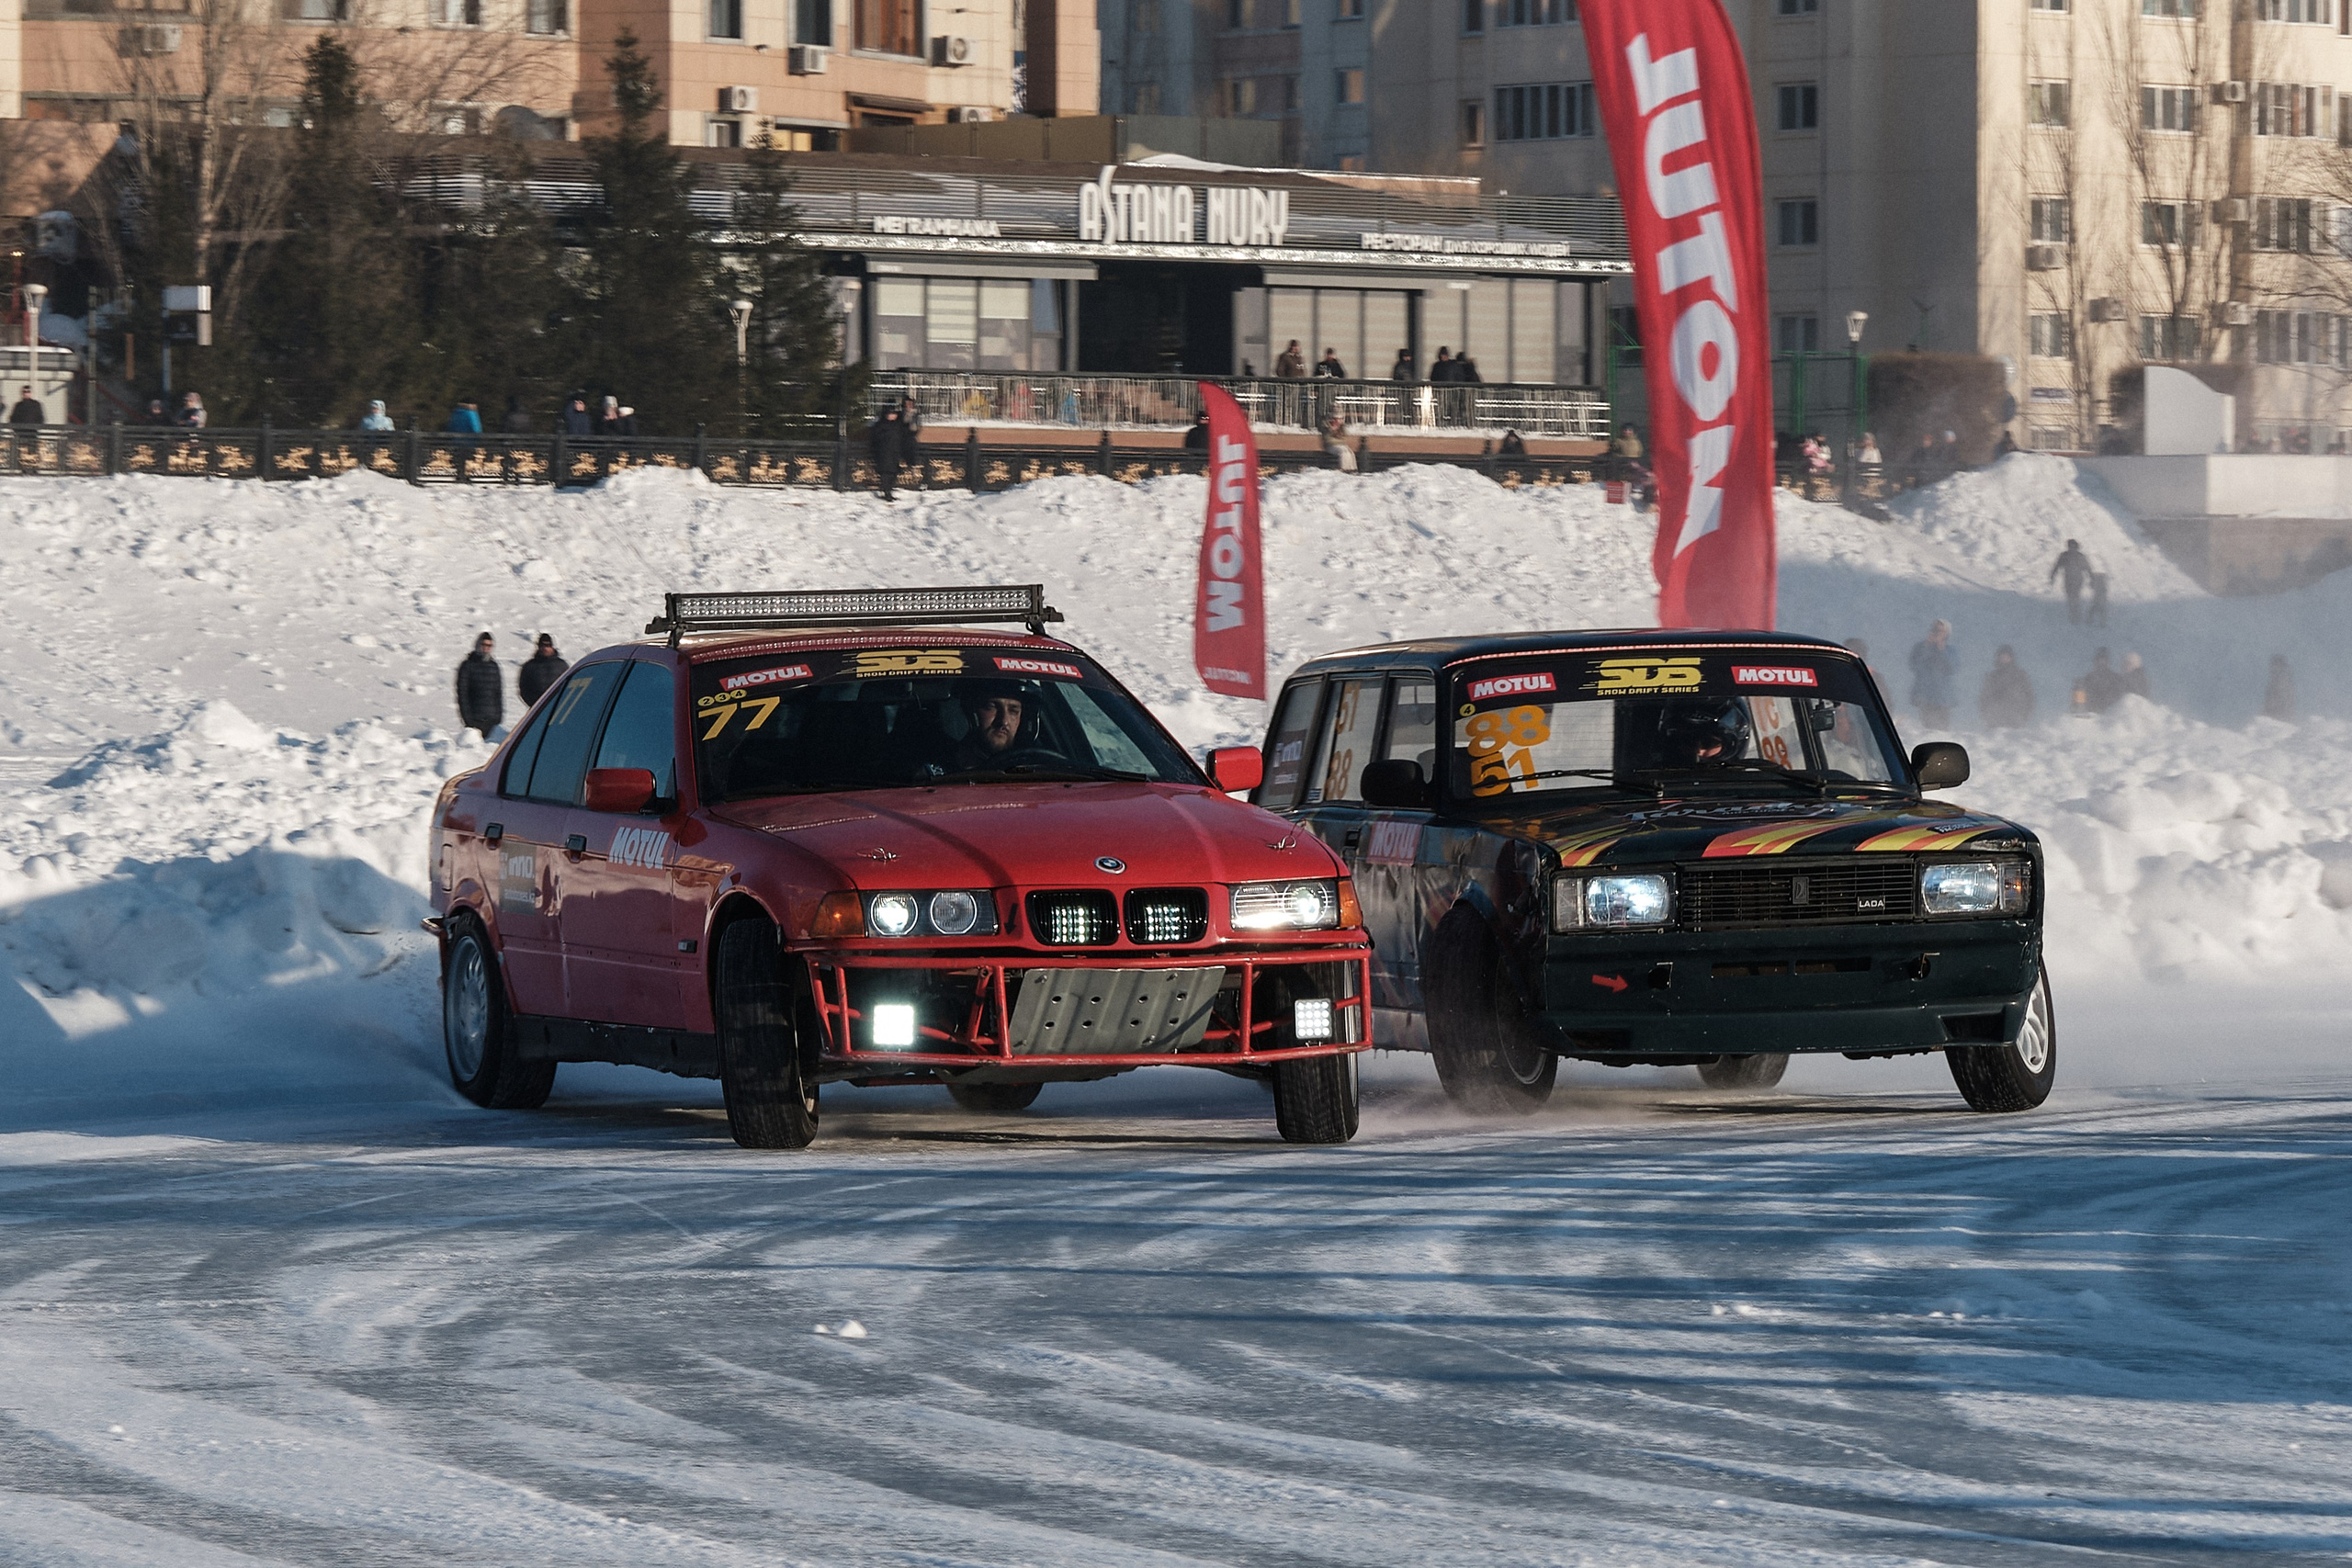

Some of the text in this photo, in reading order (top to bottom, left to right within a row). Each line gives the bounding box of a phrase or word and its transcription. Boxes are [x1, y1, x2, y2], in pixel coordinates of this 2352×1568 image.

[1080, 165, 1289, 246] ASTANA NURY
[728, 666, 808, 690] MOTUL
[1001, 660, 1078, 676] MOTUL
[1474, 675, 1552, 698] MOTUL
[1738, 669, 1814, 684] MOTUL
[548, 677, 594, 726] 77
[1661, 685, 1700, 694] SERIES
[698, 696, 780, 741] 77
[1465, 705, 1551, 758] 88
[1471, 747, 1539, 797] 51
[608, 827, 670, 870] MOTUL
[1369, 820, 1420, 860] MOTUL
